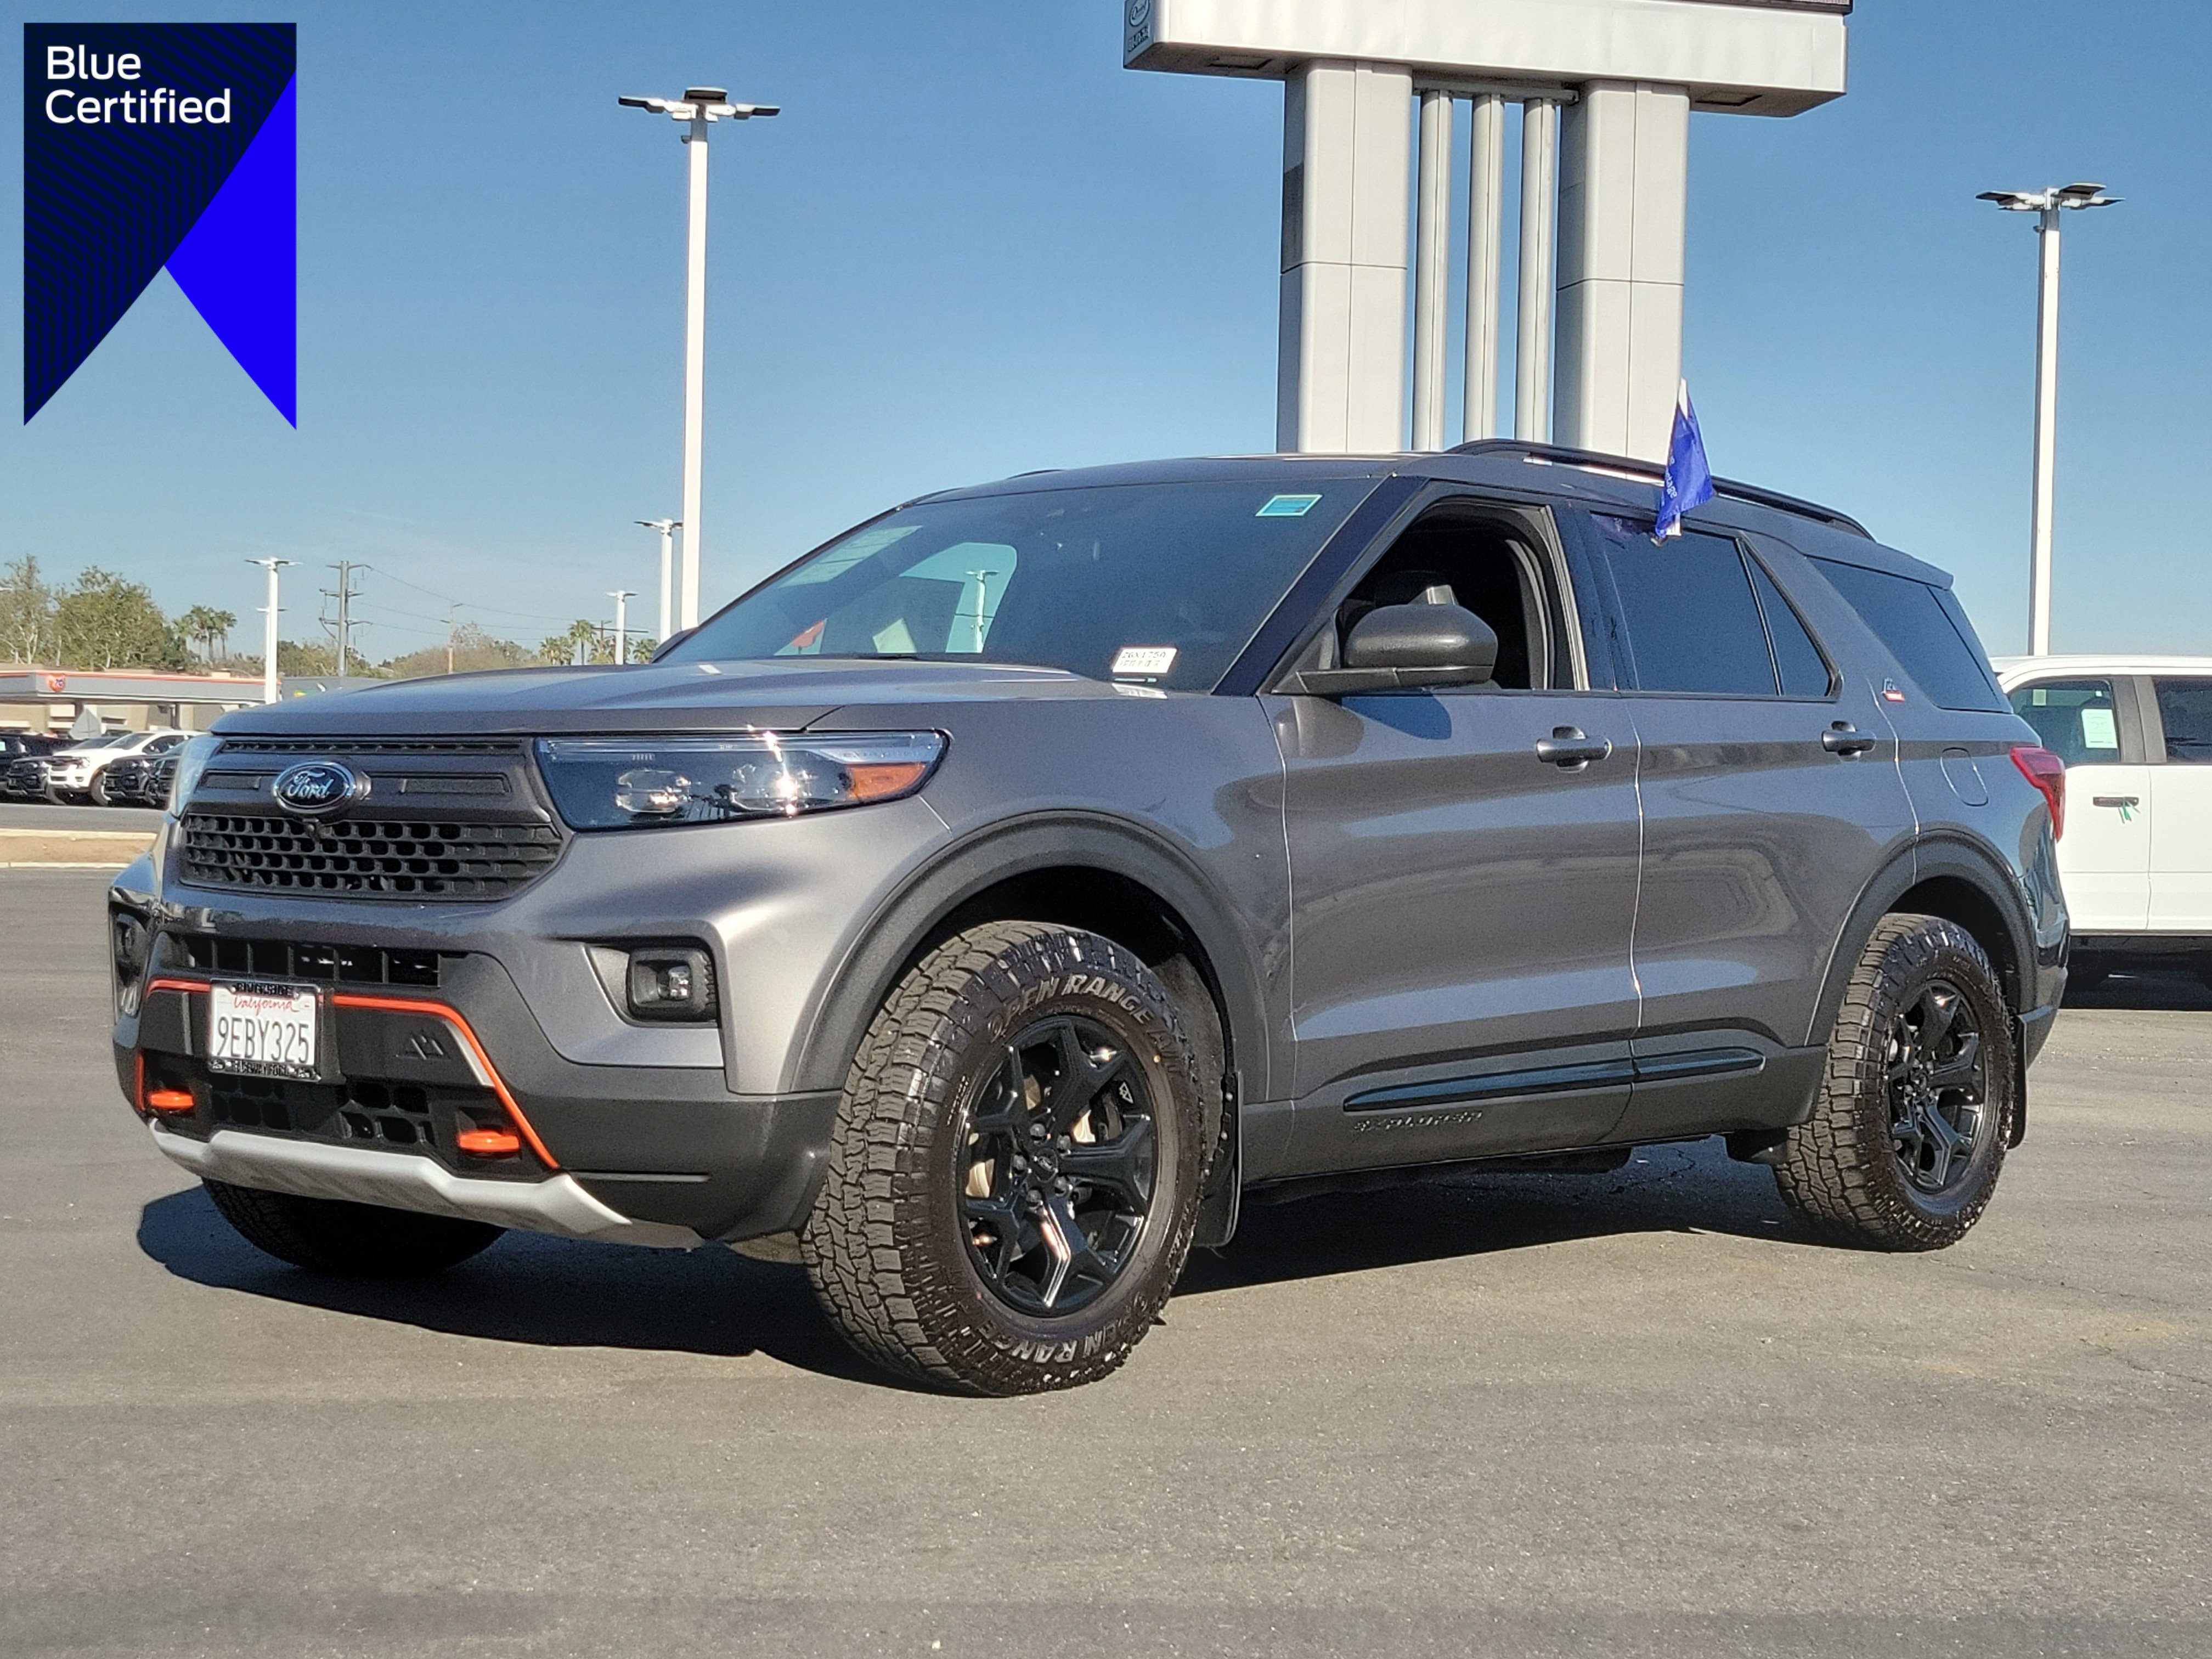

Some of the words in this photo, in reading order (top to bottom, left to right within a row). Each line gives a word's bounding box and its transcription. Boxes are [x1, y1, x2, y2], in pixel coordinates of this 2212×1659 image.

[287, 770, 335, 799] Ford
[234, 995, 300, 1015] California
[986, 976, 1060, 1043] OPEN
[1062, 973, 1158, 1025] RANGE
[217, 1016, 309, 1064] 9EBY325
[977, 1319, 1078, 1364] RANGE
